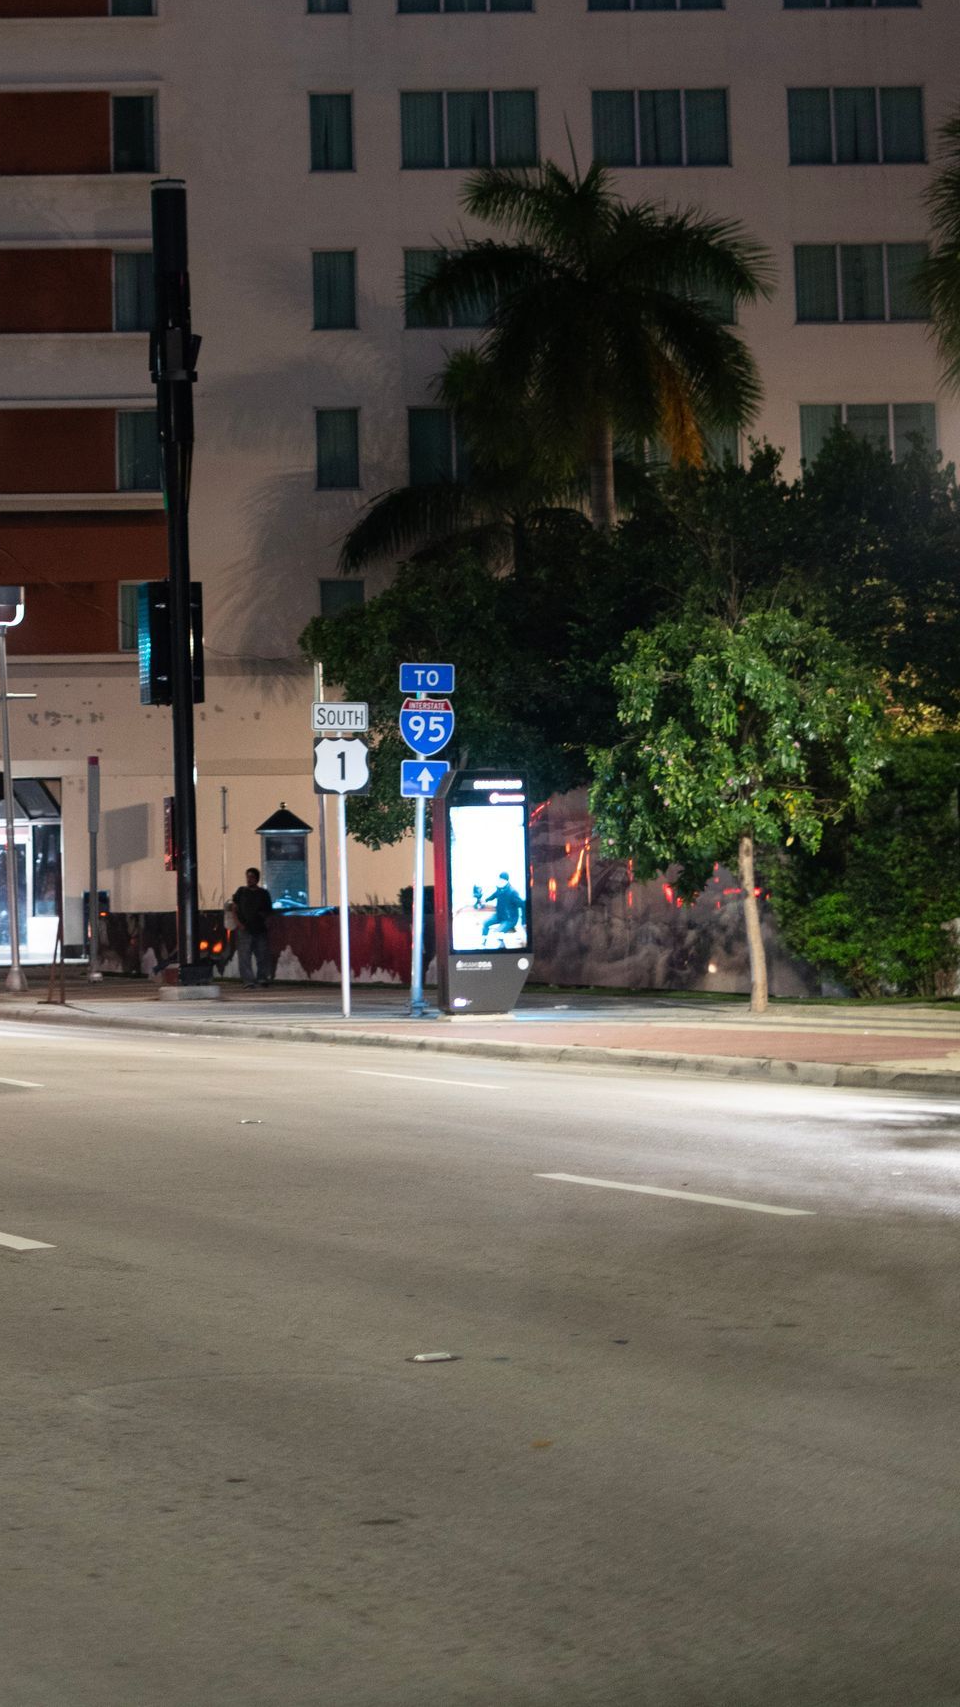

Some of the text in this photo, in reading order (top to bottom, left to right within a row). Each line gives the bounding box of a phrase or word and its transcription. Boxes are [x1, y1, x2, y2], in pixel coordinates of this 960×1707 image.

[414, 670, 439, 686] TO
[408, 702, 446, 710] INTERSTATE
[316, 707, 364, 725] SOUTH
[408, 715, 446, 742] 95
[337, 751, 346, 781] 1
